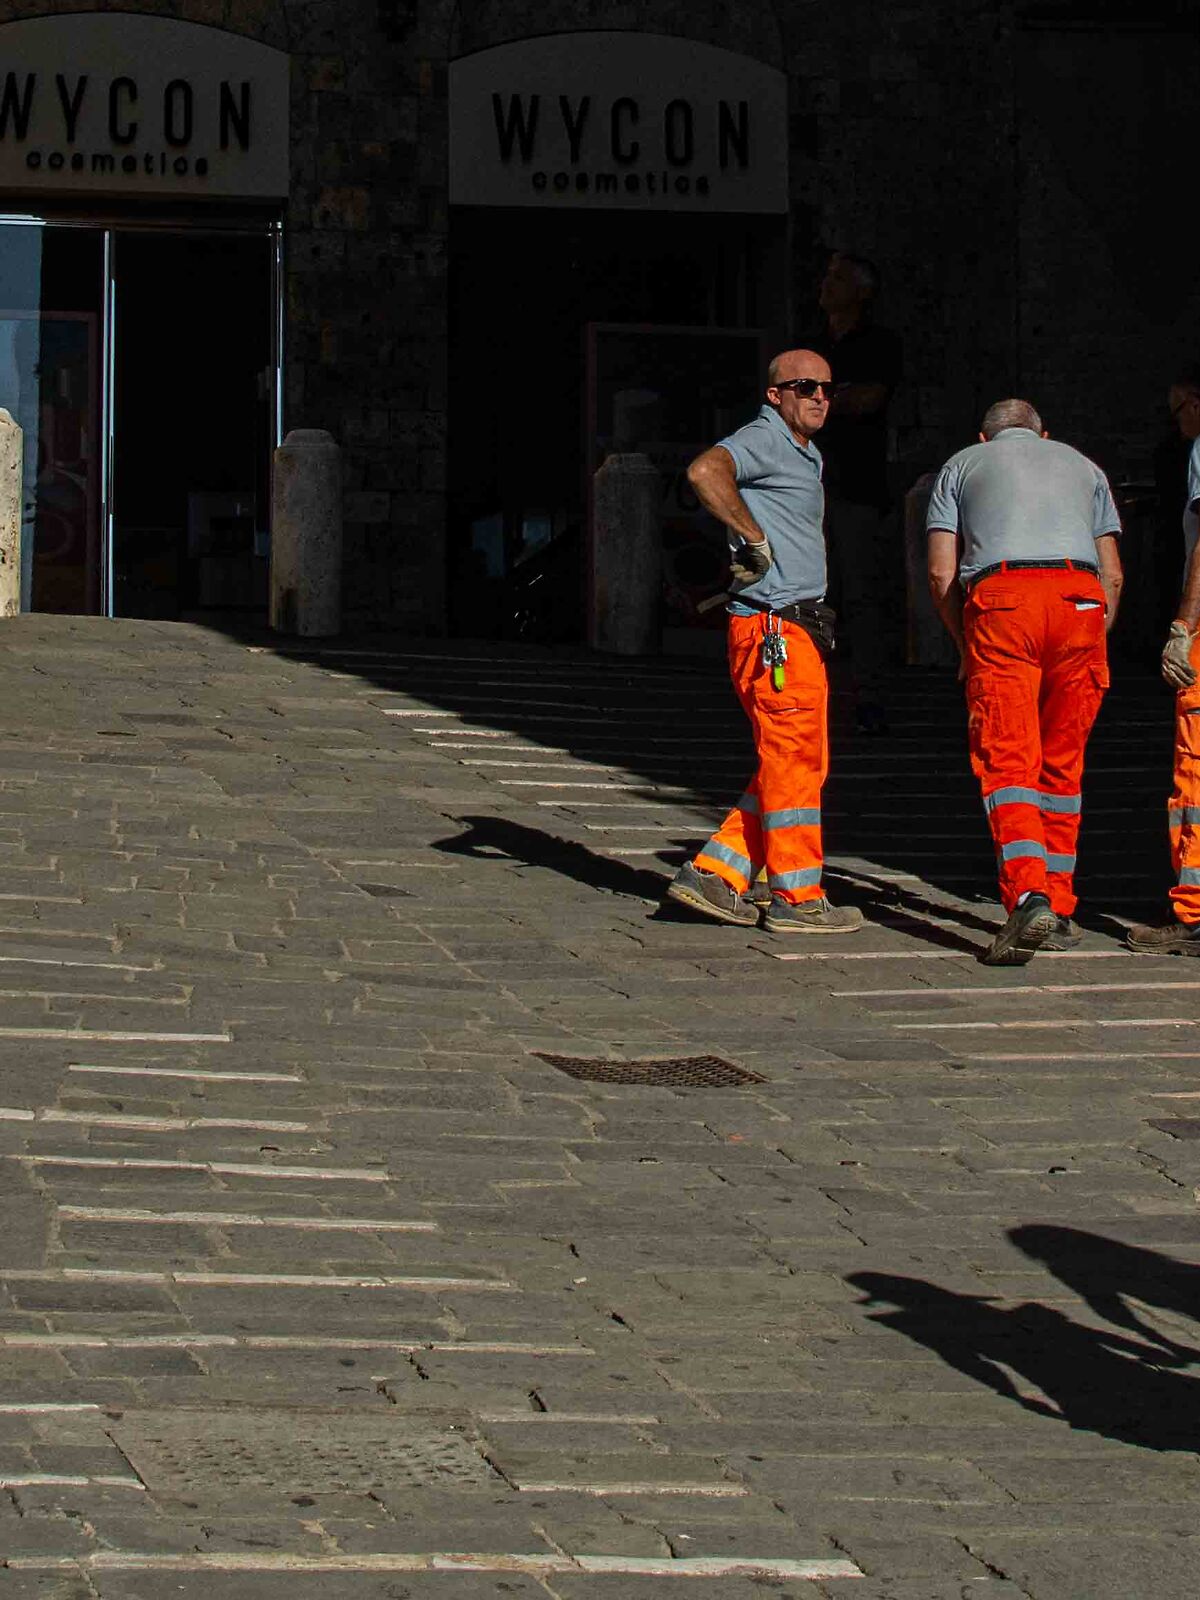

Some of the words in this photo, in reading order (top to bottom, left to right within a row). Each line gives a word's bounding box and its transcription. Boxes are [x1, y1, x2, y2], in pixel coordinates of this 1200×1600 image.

[0, 72, 250, 149] WYCON
[492, 94, 748, 168] WYCON
[26, 152, 208, 176] cosmetics
[532, 171, 710, 194] cosmetics
